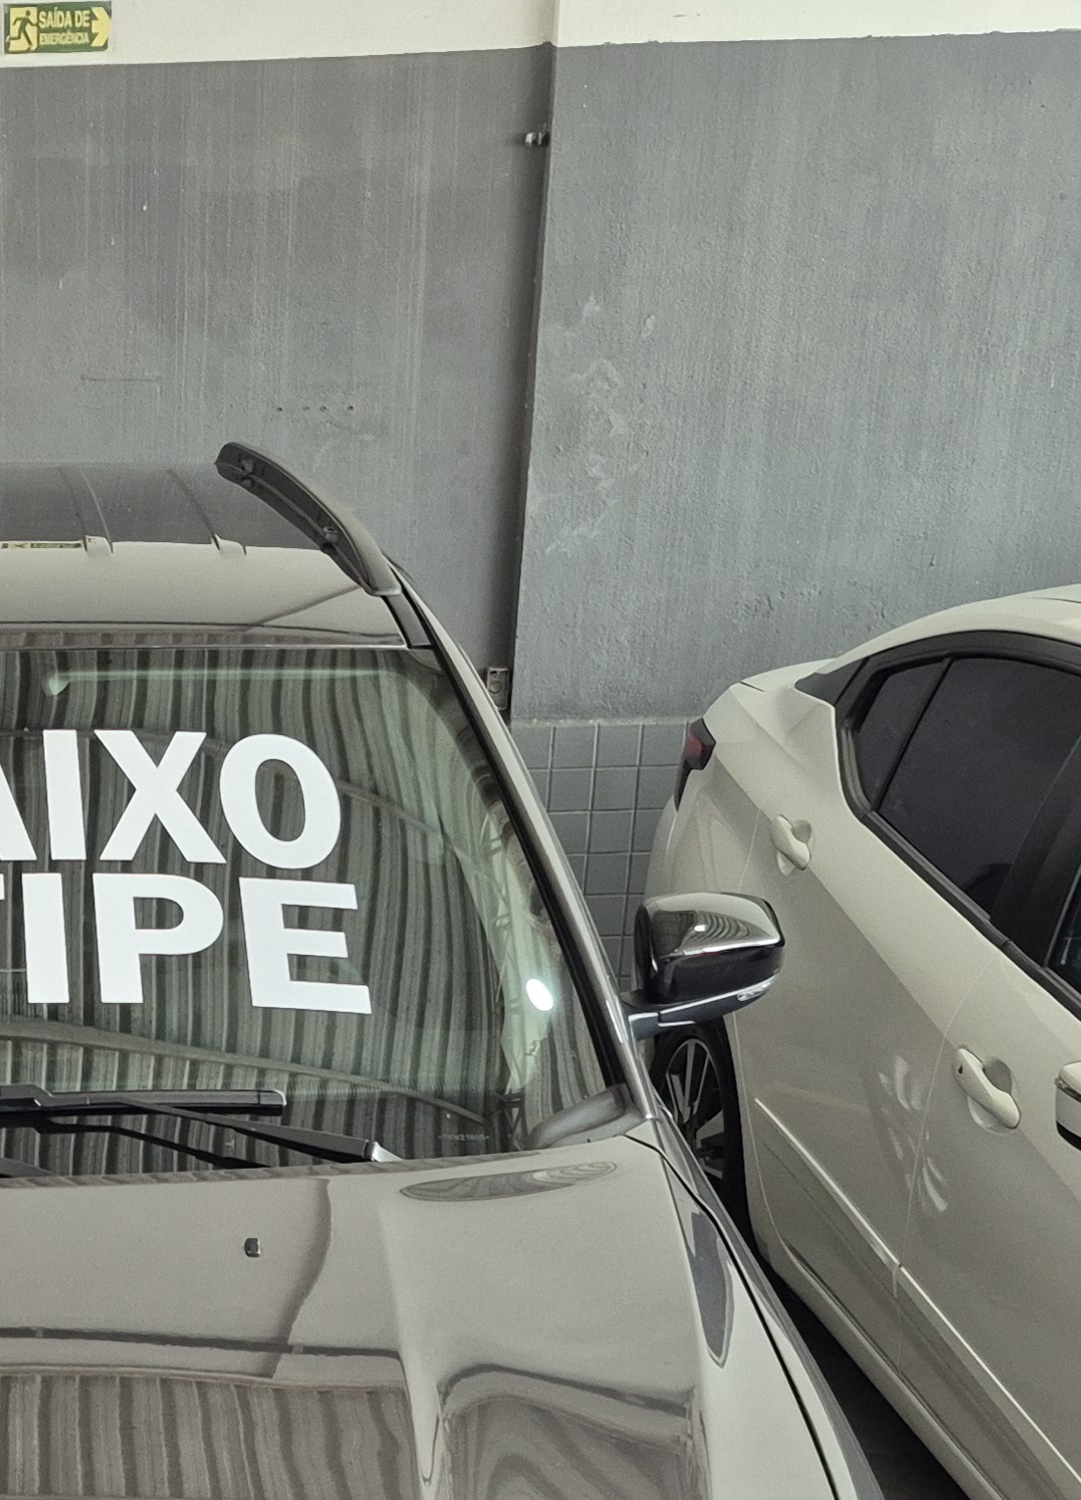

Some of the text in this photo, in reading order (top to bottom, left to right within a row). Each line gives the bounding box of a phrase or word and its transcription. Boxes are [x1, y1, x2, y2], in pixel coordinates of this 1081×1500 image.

[39, 6, 90, 28] SAÍDA DE
[39, 30, 90, 45] EMERGÊNCIA
